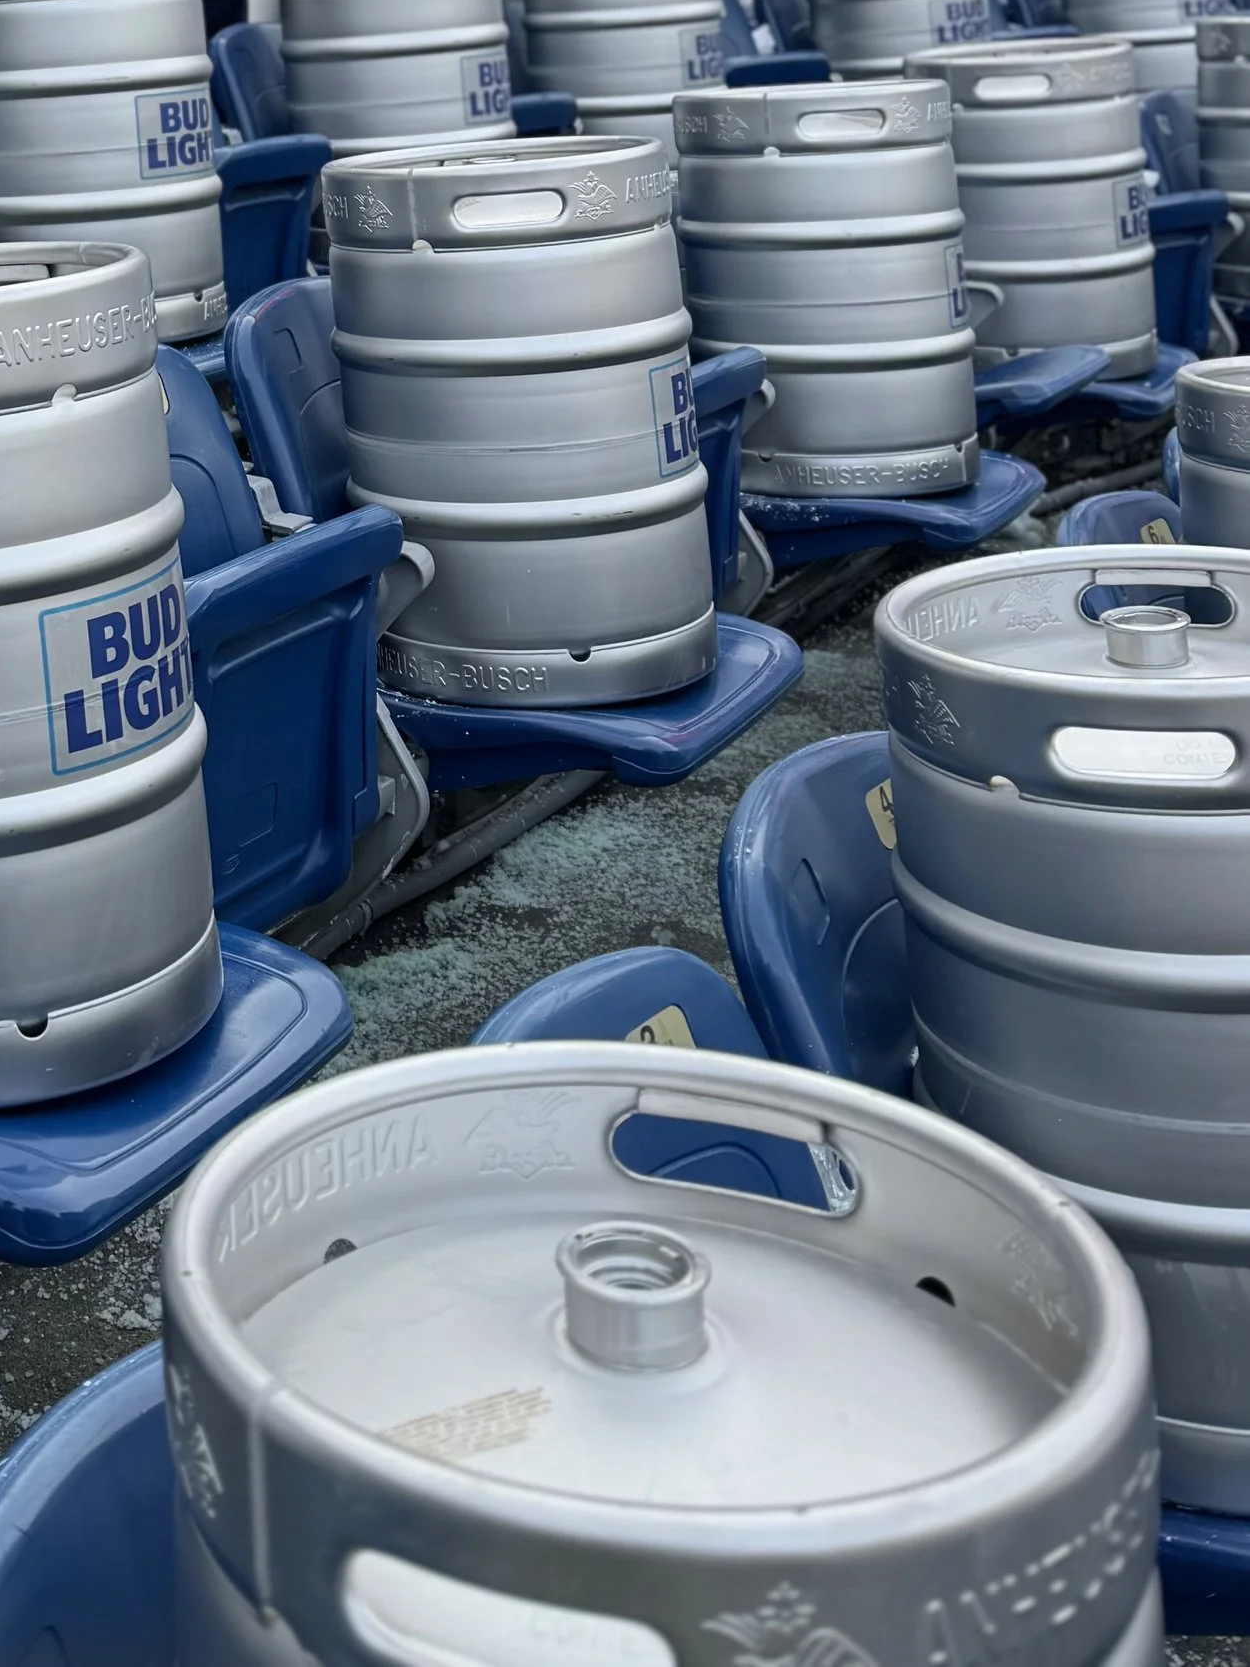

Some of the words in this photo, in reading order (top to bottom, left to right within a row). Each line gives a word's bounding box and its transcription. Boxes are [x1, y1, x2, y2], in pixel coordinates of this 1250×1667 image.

[159, 97, 210, 134] BUD
[146, 131, 213, 171] LIGH
[87, 583, 183, 680] BUD
